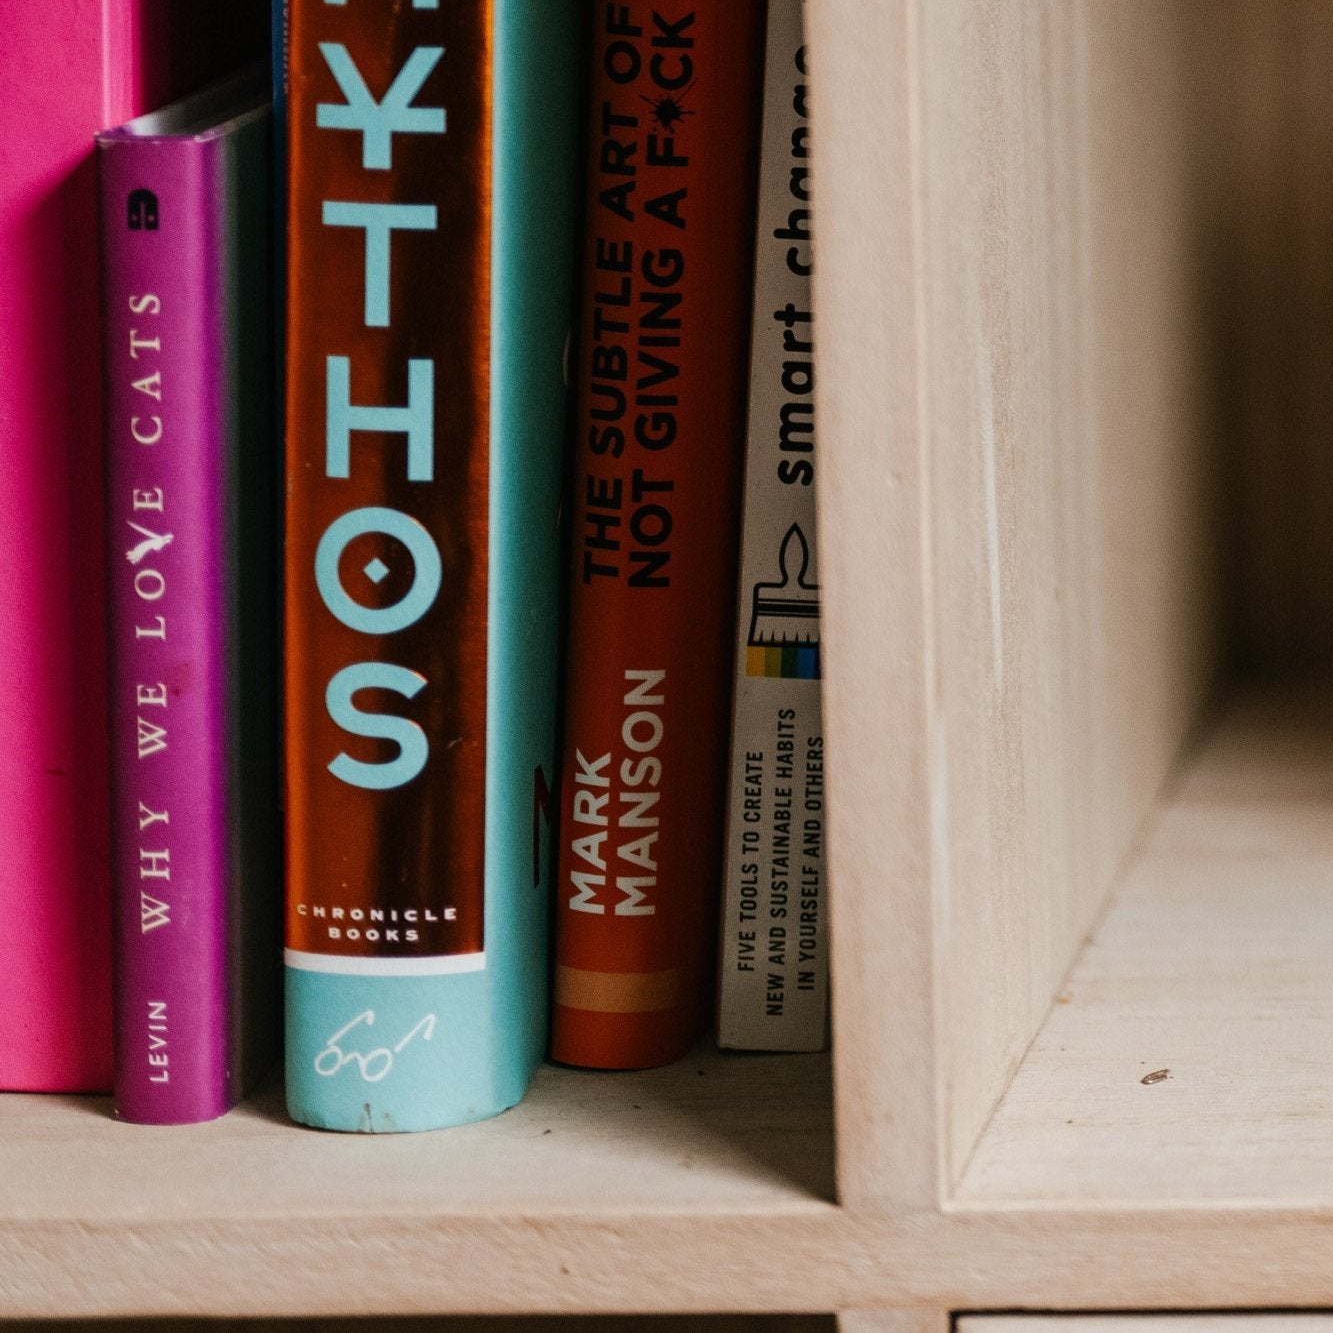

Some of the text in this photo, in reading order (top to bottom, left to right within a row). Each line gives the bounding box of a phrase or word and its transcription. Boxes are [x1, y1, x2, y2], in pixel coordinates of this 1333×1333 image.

[583, 3, 643, 585] THE SUBTLE ART OF
[646, 186, 687, 229] A
[637, 248, 685, 450] GIVING
[774, 303, 815, 486] smart
[127, 293, 173, 934] WHY WE LOVE CATS
[629, 469, 673, 588] NOT
[569, 747, 612, 915] MARK
[615, 669, 667, 918] MANSON
[737, 751, 764, 971] FIVE TOOLS TO CREATE
[766, 708, 796, 1016] NEW AND SUSTAINABLE HABITS
[797, 736, 823, 990] IN YOURSELF AND OTHERS
[296, 902, 458, 923] CHRONICLE
[328, 927, 420, 943] BOOKS
[149, 1000, 168, 1082] LEVIN
